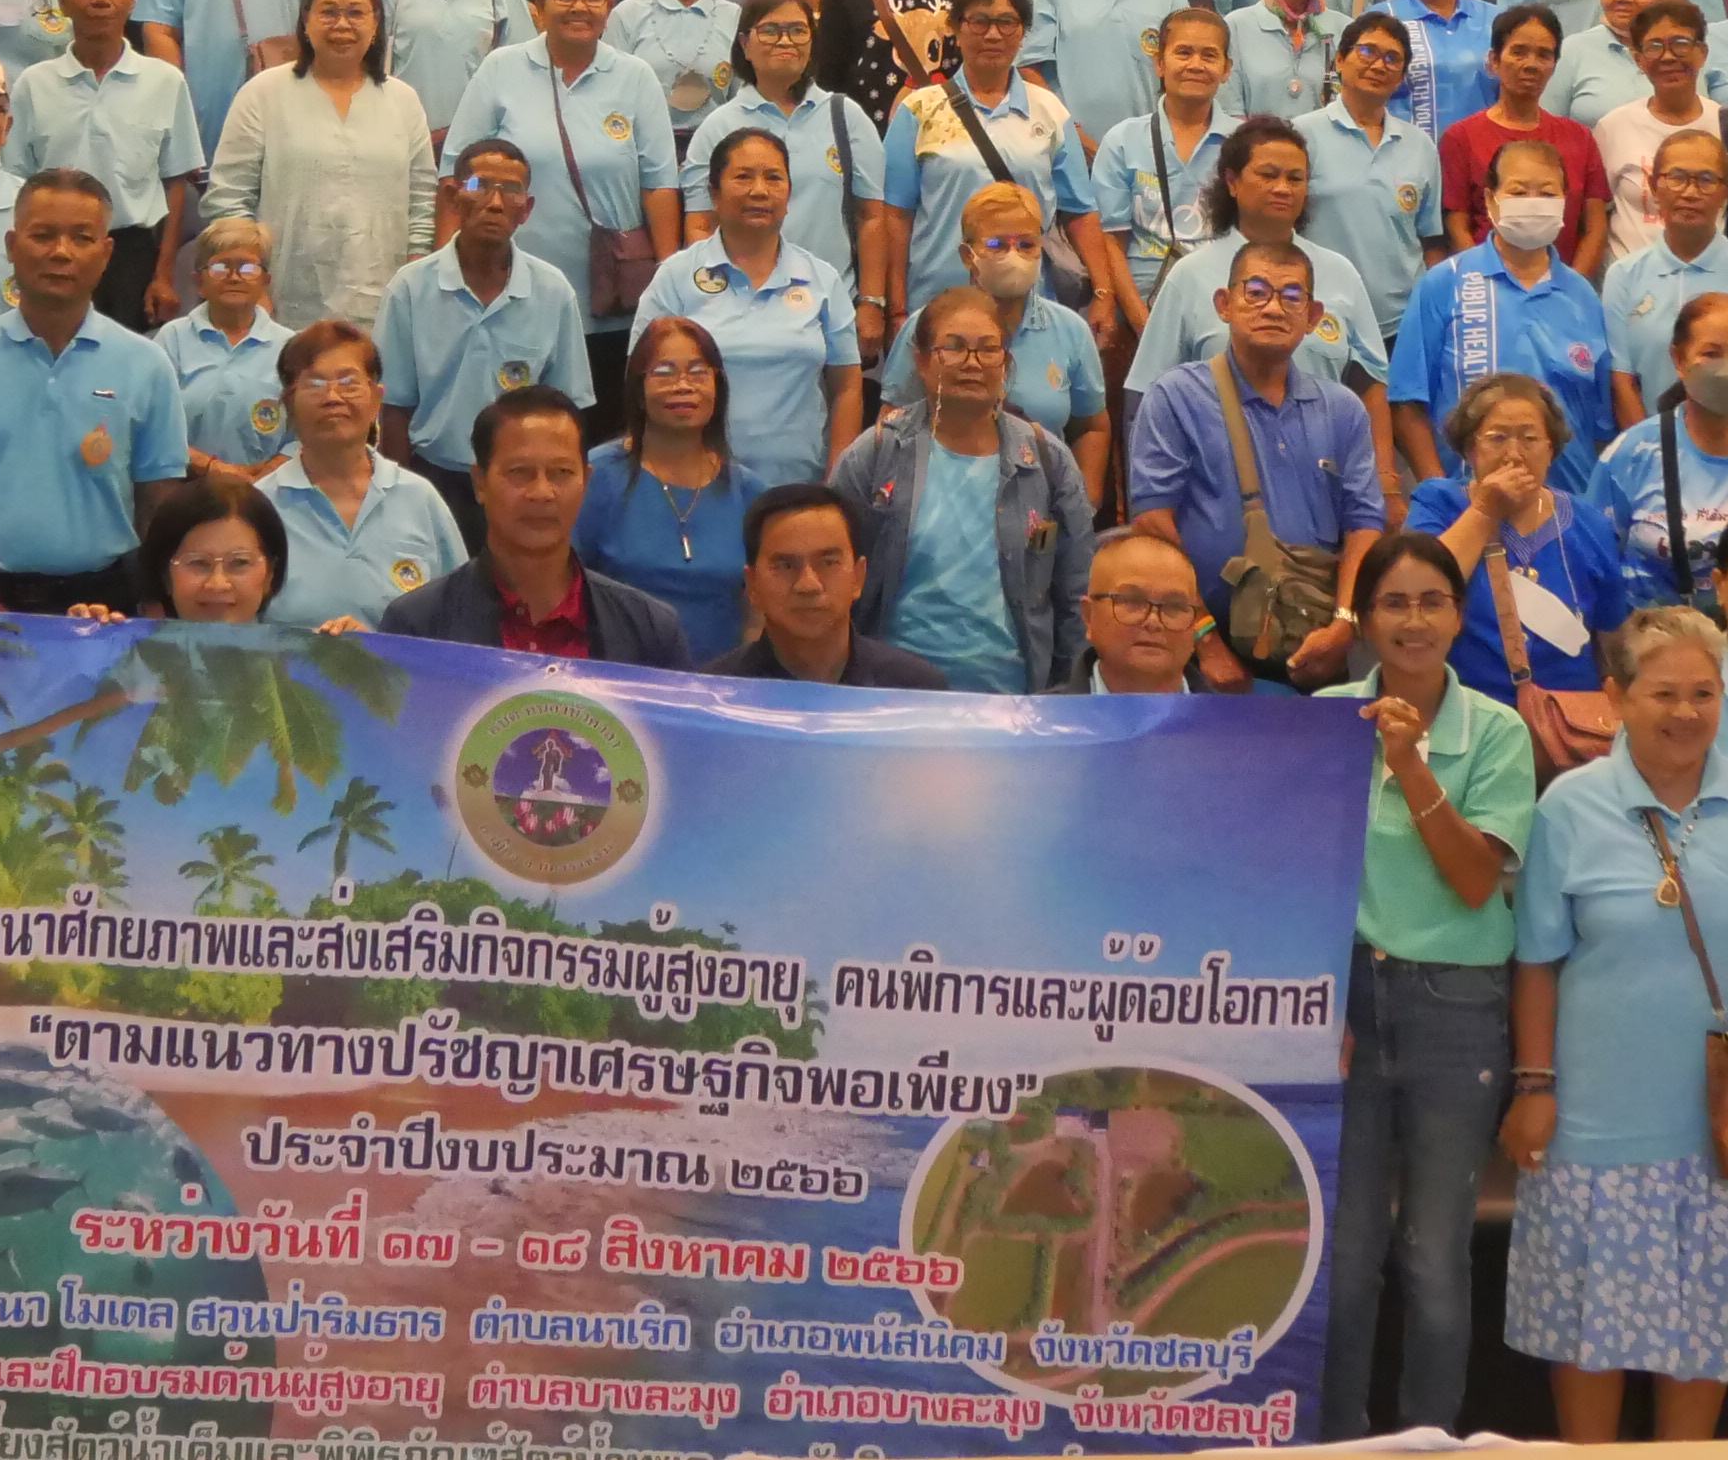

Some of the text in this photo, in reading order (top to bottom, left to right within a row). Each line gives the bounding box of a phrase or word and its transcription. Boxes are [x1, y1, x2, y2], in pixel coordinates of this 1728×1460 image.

[1461, 271, 1487, 324] PUBLIC
[835, 937, 1328, 1042] คนพิการและผู้ด้อยโอกาส
[247, 1117, 863, 1197] ประจำปีงบประมาณ ๒๕๖๖
[75, 1188, 361, 1258] ระหว่างวันที่
[383, 1233, 455, 1262] ๑๗
[522, 1234, 585, 1267] ๑๘
[606, 1221, 804, 1278] สิงหาคม
[827, 1251, 960, 1286] ๒๕๖๖
[65, 1281, 173, 1328] โมเดล
[191, 1283, 442, 1337] สวนป่าริมธาร
[474, 1300, 687, 1346] ตำบลนาเริก
[720, 1311, 1004, 1362] อำเภอพนัสนิคม
[1035, 1323, 1254, 1377] จังหวัดชลบุรี
[472, 1365, 736, 1424] ตำบลบางละมุง
[768, 1375, 1042, 1436] อำเภอบางละมุง
[1073, 1388, 1294, 1445] จังหวัดชลบุรี
